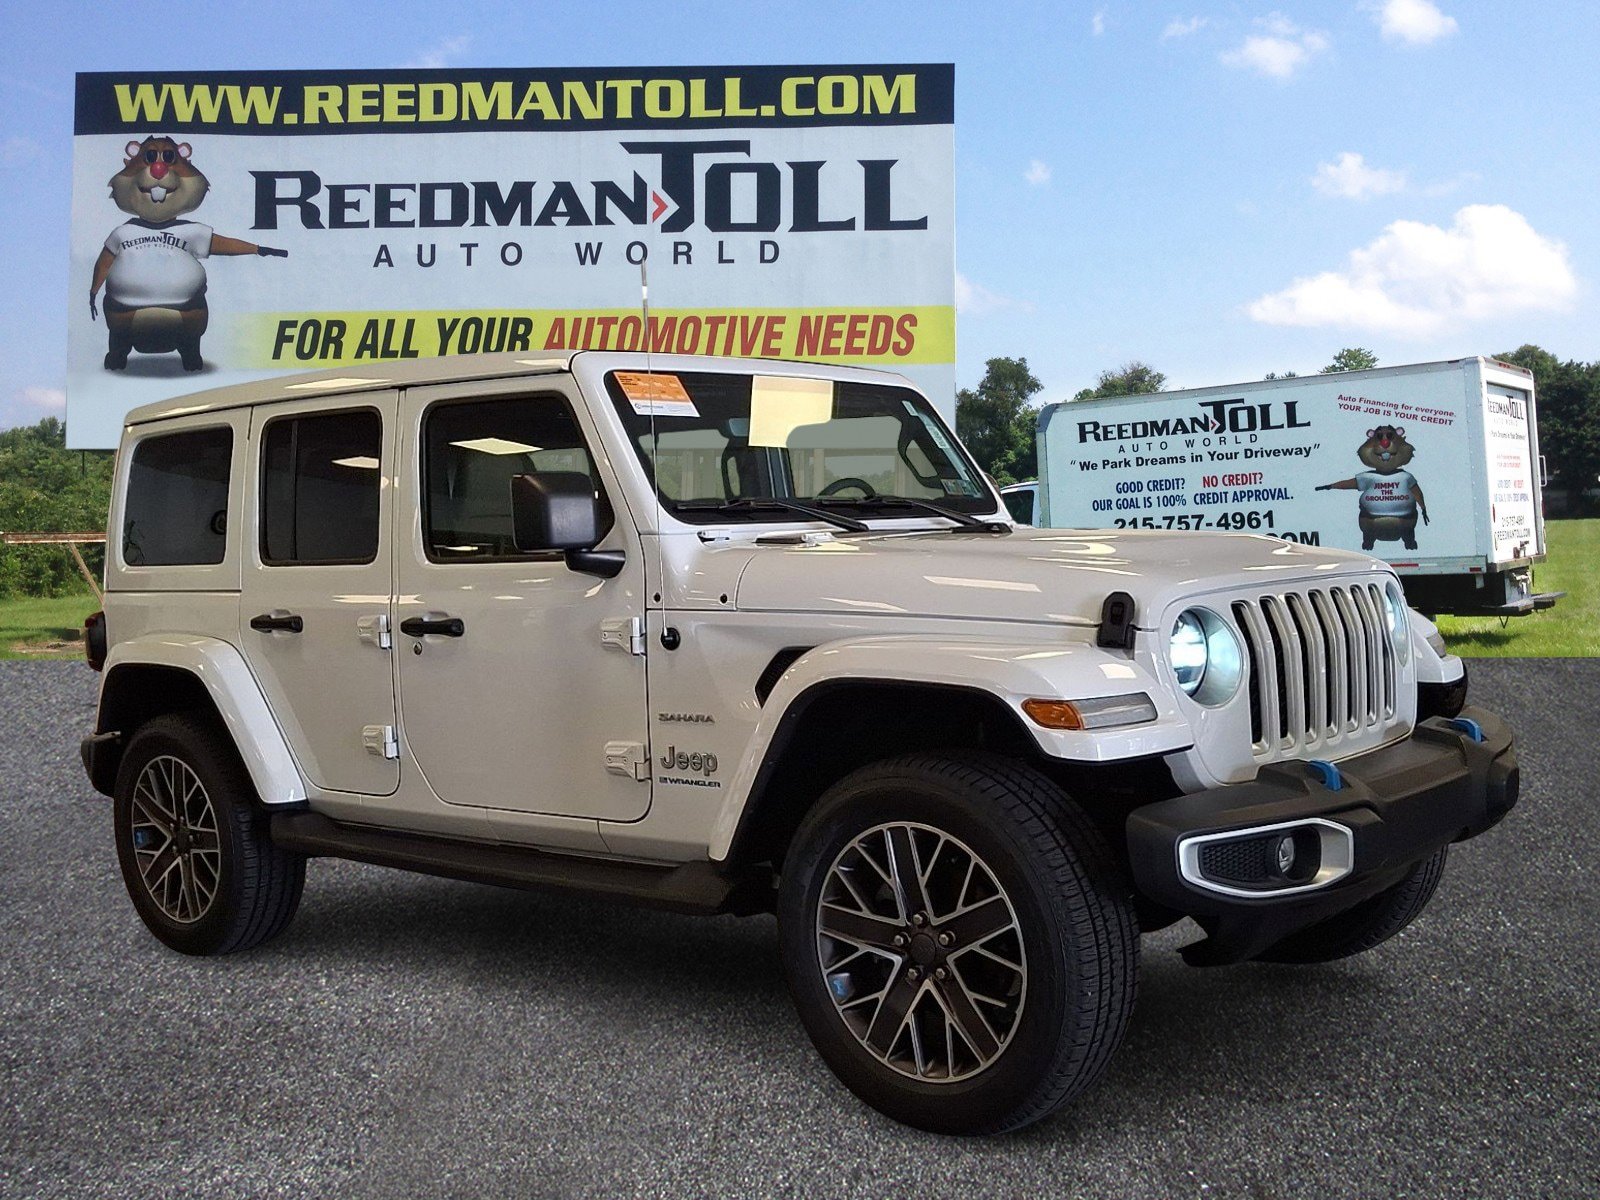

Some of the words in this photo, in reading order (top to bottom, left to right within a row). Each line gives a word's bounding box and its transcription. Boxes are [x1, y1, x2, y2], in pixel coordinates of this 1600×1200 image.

[114, 74, 916, 124] WWW.REEDMANTOLL.COM
[373, 242, 523, 268] AUTO
[575, 240, 780, 265] WORLD
[272, 318, 346, 360] FOR
[355, 317, 419, 359] ALL
[437, 316, 533, 356] YOUR
[544, 314, 786, 356] AUTOMOTIVE
[795, 313, 917, 356] NEEDS
[1338, 394, 1356, 402] Auto
[1359, 397, 1399, 410] Financing
[1401, 403, 1413, 411] for
[1415, 406, 1456, 418] everyone.
[1338, 403, 1361, 412] YOUR
[1363, 407, 1380, 415] JOB
[1394, 411, 1418, 421] YOUR
[1421, 415, 1453, 426] CREDIT
[1118, 441, 1168, 454] AUTO
[1185, 433, 1258, 448] WORLD
[1102, 457, 1131, 470] Park
[1135, 455, 1187, 467] Dreams
[1190, 452, 1203, 463] in
[1207, 450, 1240, 461] Your
[1116, 481, 1143, 494] GOOD
[1147, 477, 1186, 492] CREDIT?
[1202, 475, 1218, 488] NO
[1222, 472, 1263, 487] CREDIT?
[1374, 482, 1400, 490] JIMMY
[1092, 499, 1113, 512] OUR
[1116, 497, 1141, 510] GOAL
[1143, 496, 1153, 509] IS
[1156, 494, 1187, 507] 100%
[1193, 491, 1229, 505] CREDIT
[1232, 487, 1294, 503] APPROVAL.
[1113, 510, 1275, 531] 215-757-4961
[1265, 531, 1320, 547] OM
[658, 713, 715, 724] SAHARA
[660, 745, 718, 777] Jeep
[667, 777, 721, 788] WRANGLER
